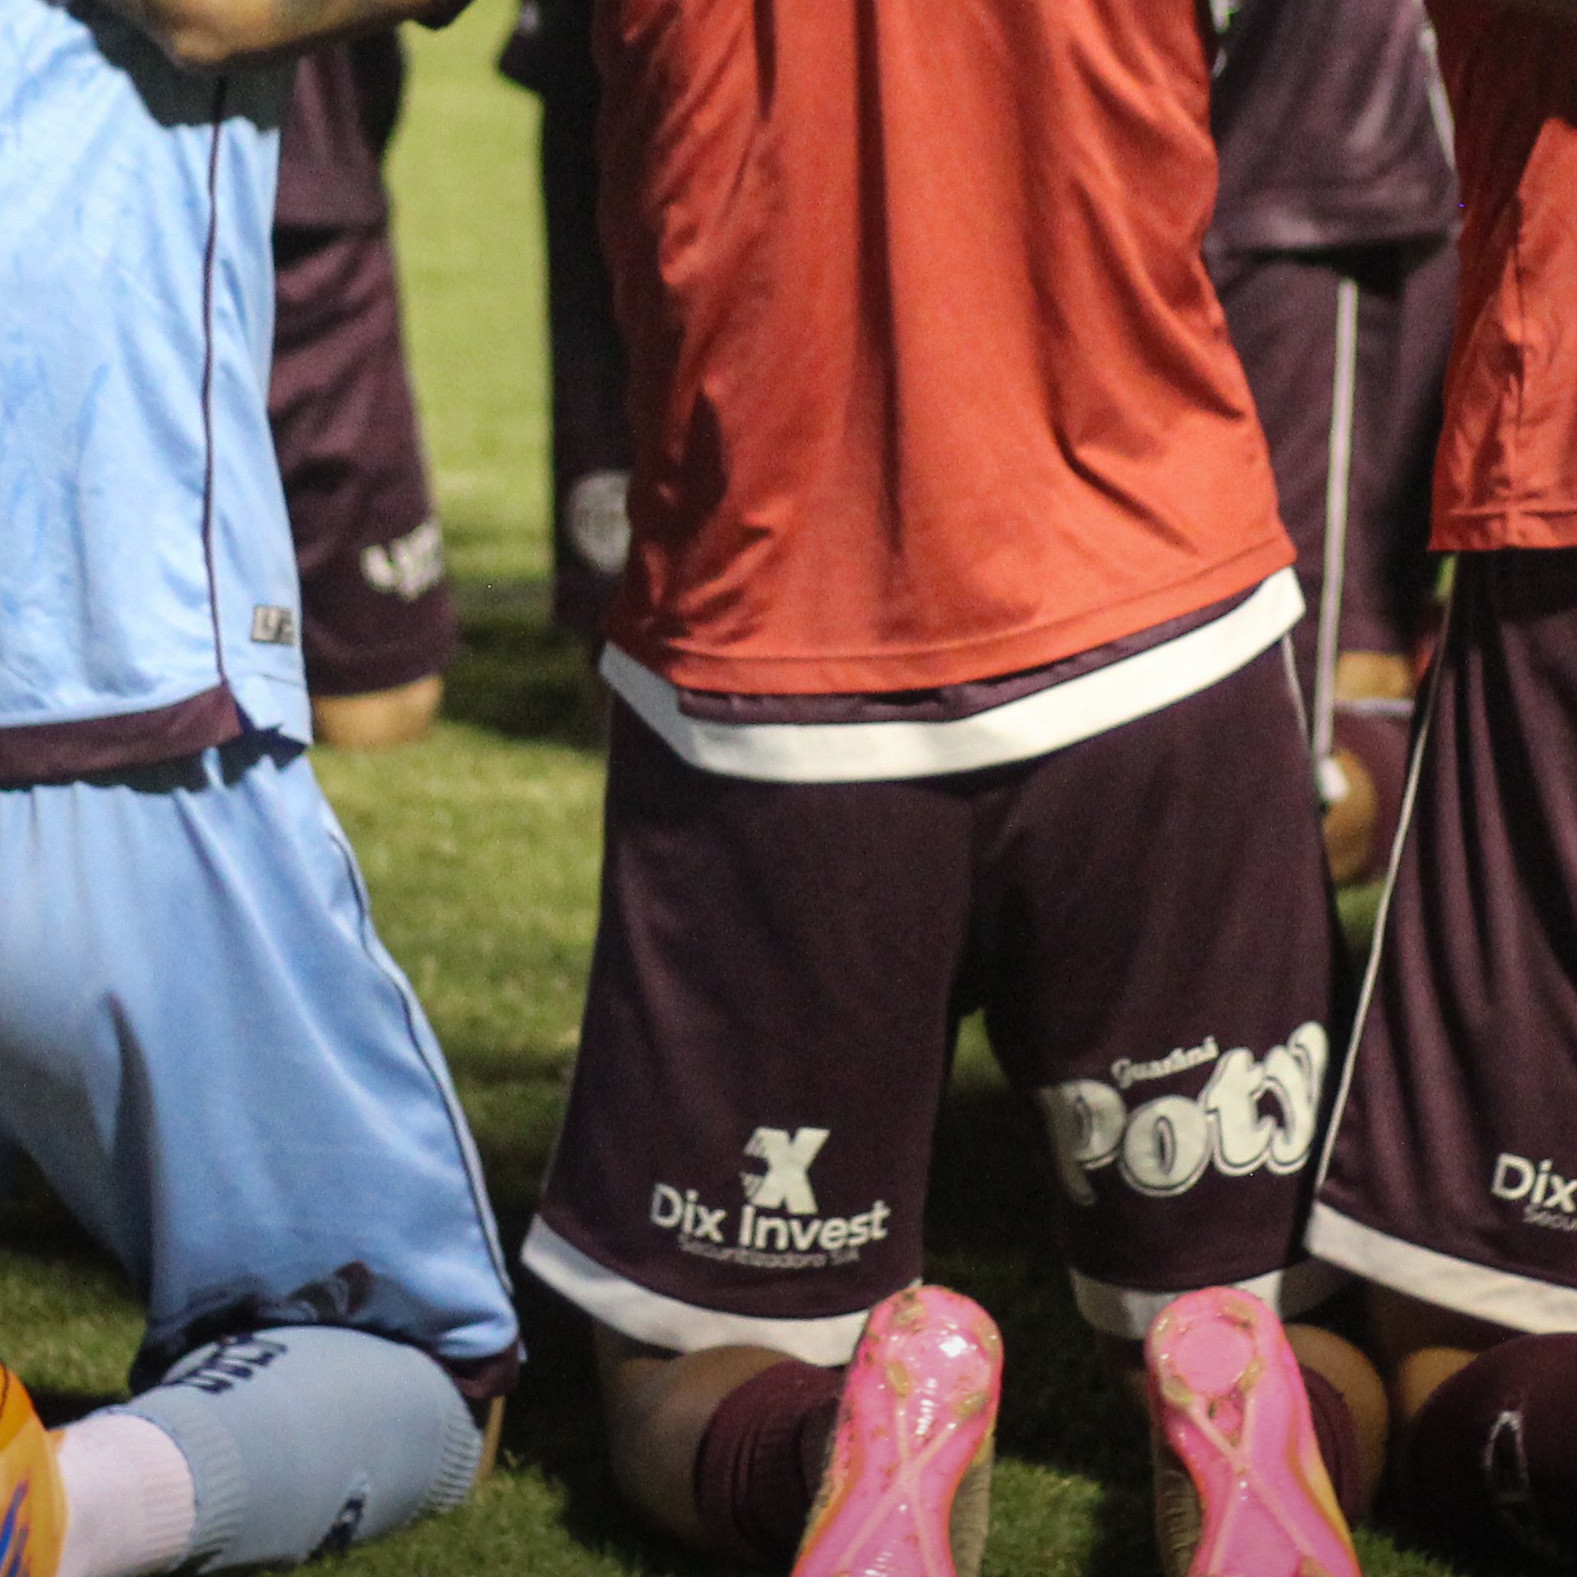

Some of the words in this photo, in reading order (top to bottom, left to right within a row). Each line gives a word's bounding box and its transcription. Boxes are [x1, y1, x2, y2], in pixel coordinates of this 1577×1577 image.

[1037, 1019, 1330, 1207] Poty
[650, 1182, 728, 1244] Dix
[737, 1199, 892, 1252] Invest
